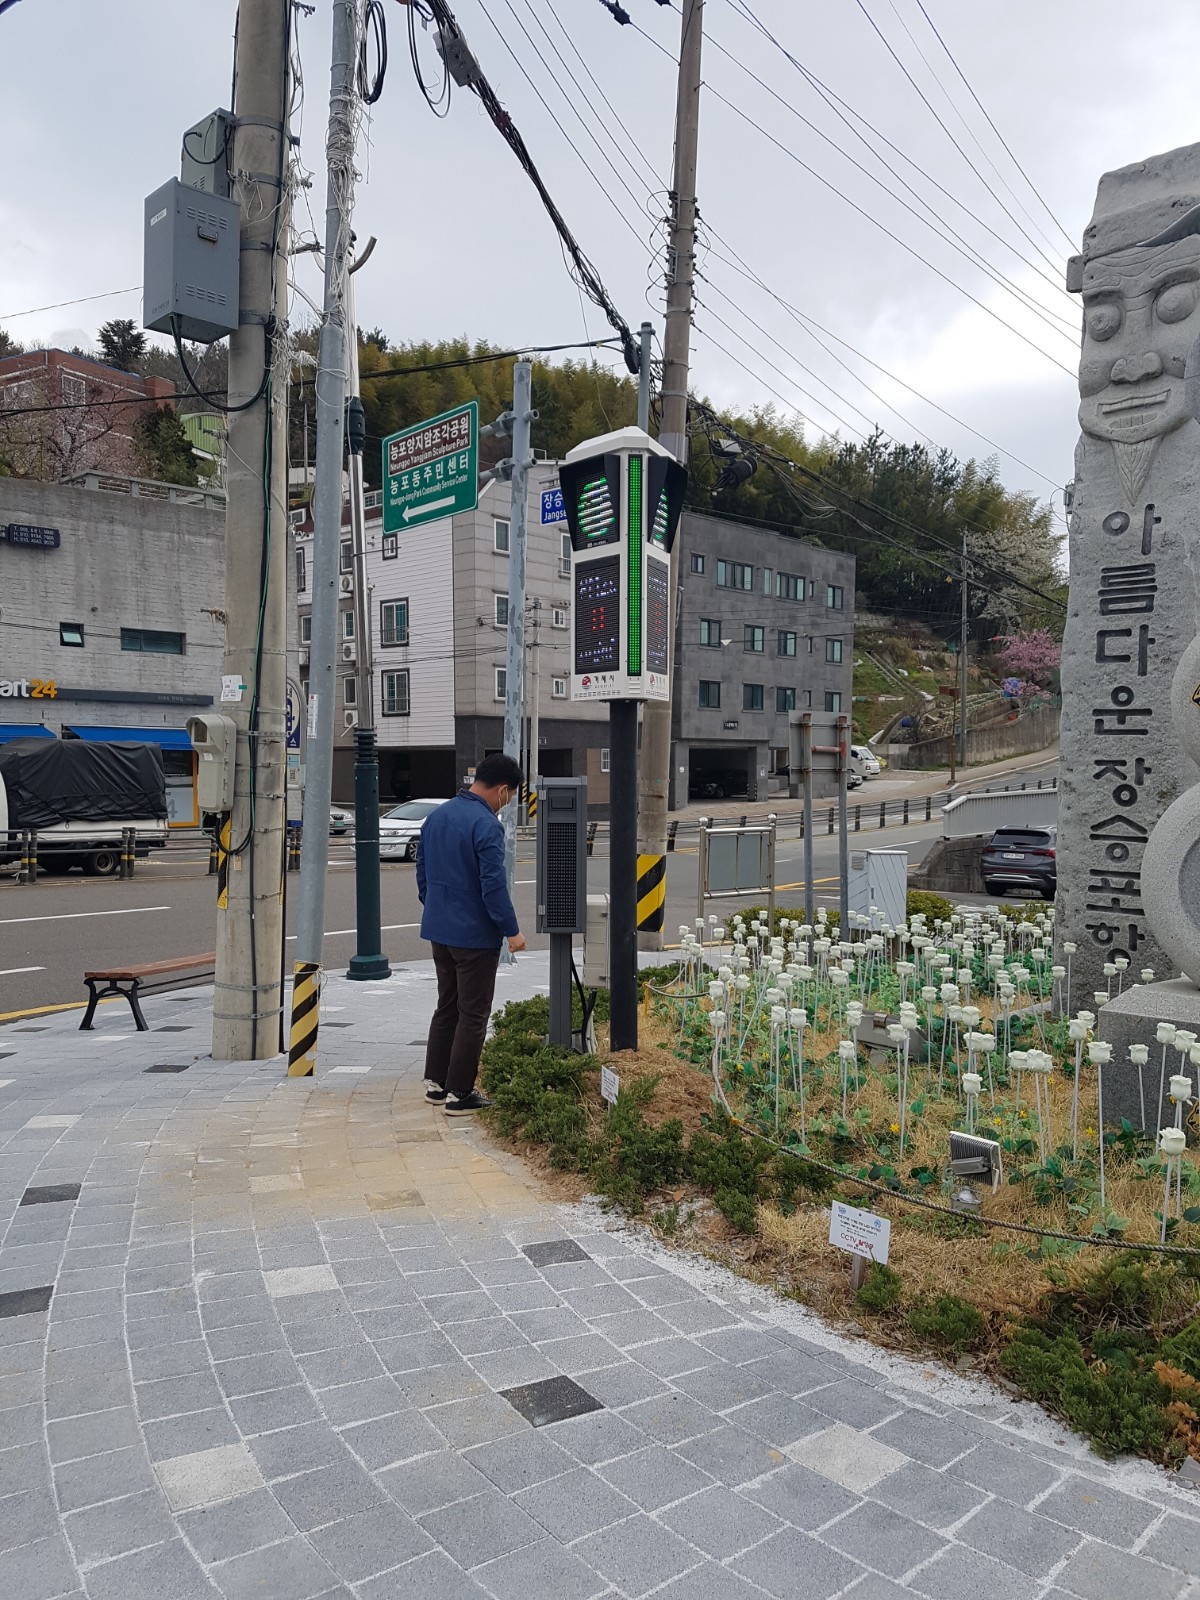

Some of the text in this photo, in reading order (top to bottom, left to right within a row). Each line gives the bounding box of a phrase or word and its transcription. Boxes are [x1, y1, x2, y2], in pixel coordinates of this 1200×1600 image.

[390, 415, 469, 461] 능포양지암조각공원
[432, 441, 456, 457] Sculpture
[456, 435, 469, 448] Park
[543, 491, 564, 509] 장승
[1092, 503, 1163, 736] 아름다운
[1085, 757, 1153, 972] 장승포항
